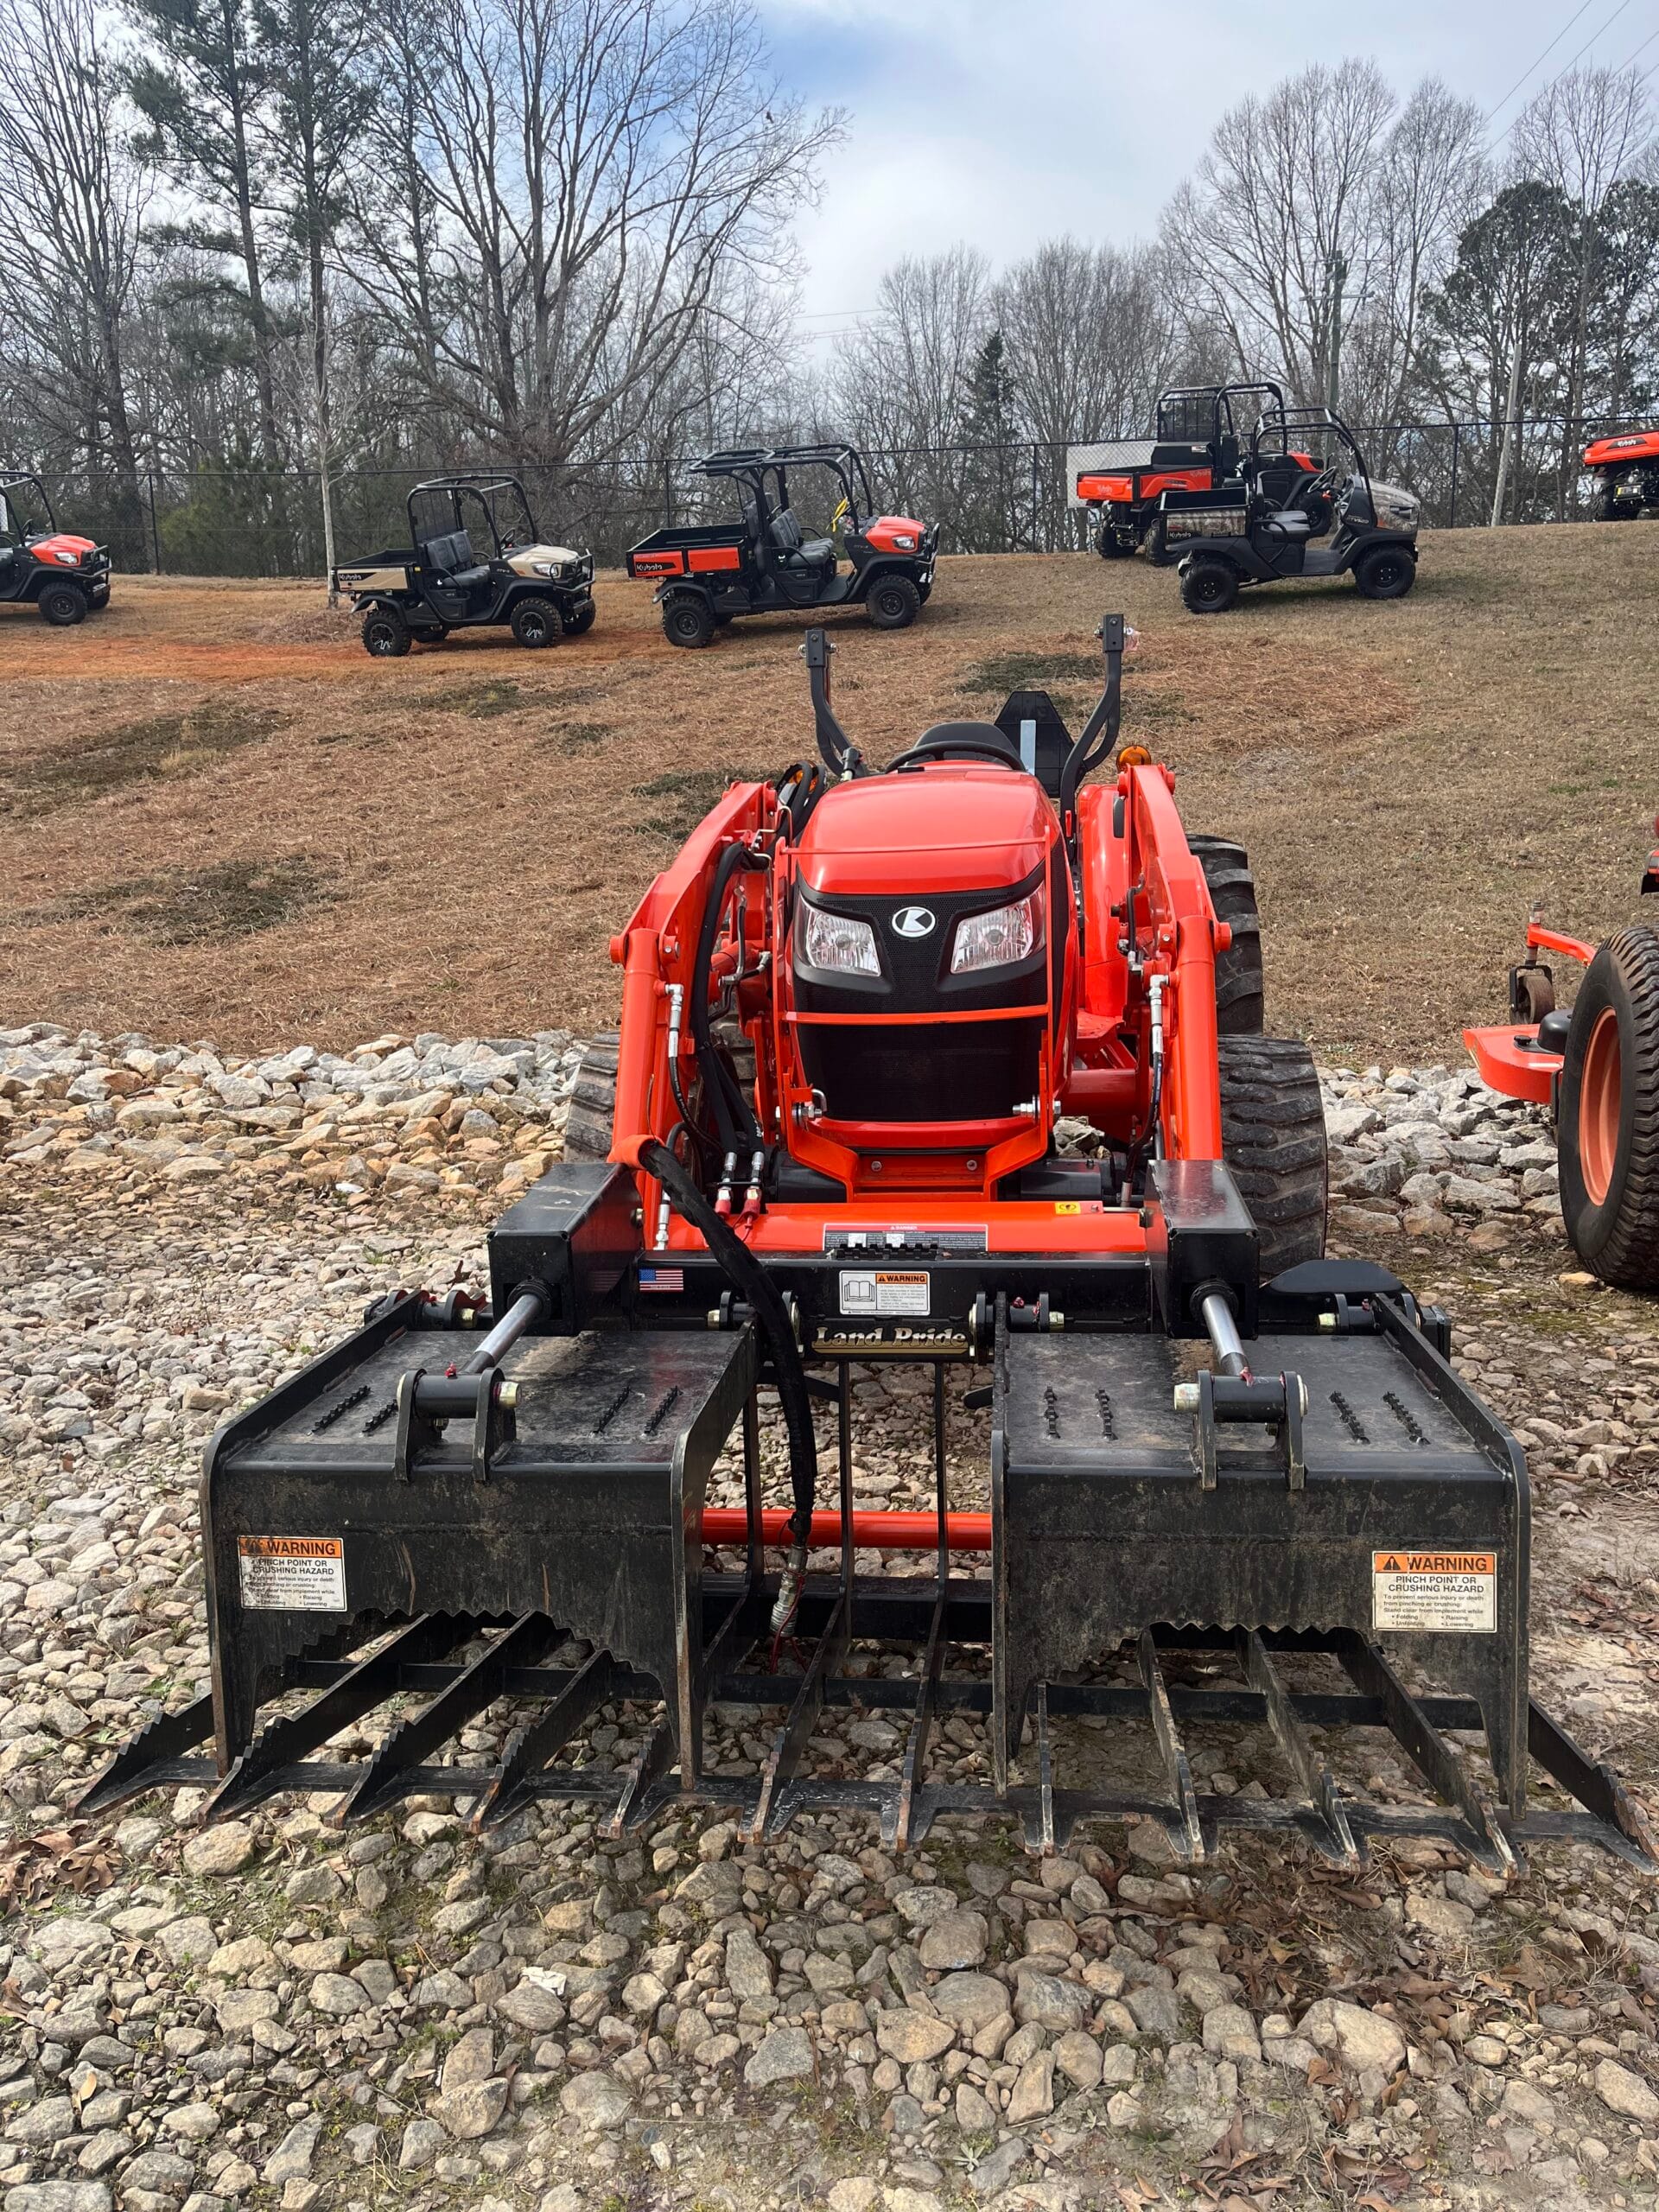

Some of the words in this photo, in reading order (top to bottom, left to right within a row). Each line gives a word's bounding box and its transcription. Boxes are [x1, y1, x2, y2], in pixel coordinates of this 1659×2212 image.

[814, 1327, 883, 1346] Land
[892, 1327, 966, 1346] Pride
[267, 1541, 335, 1554] WARNING
[1408, 1557, 1487, 1571] WARNING
[1389, 1584, 1440, 1592] CRUSHING
